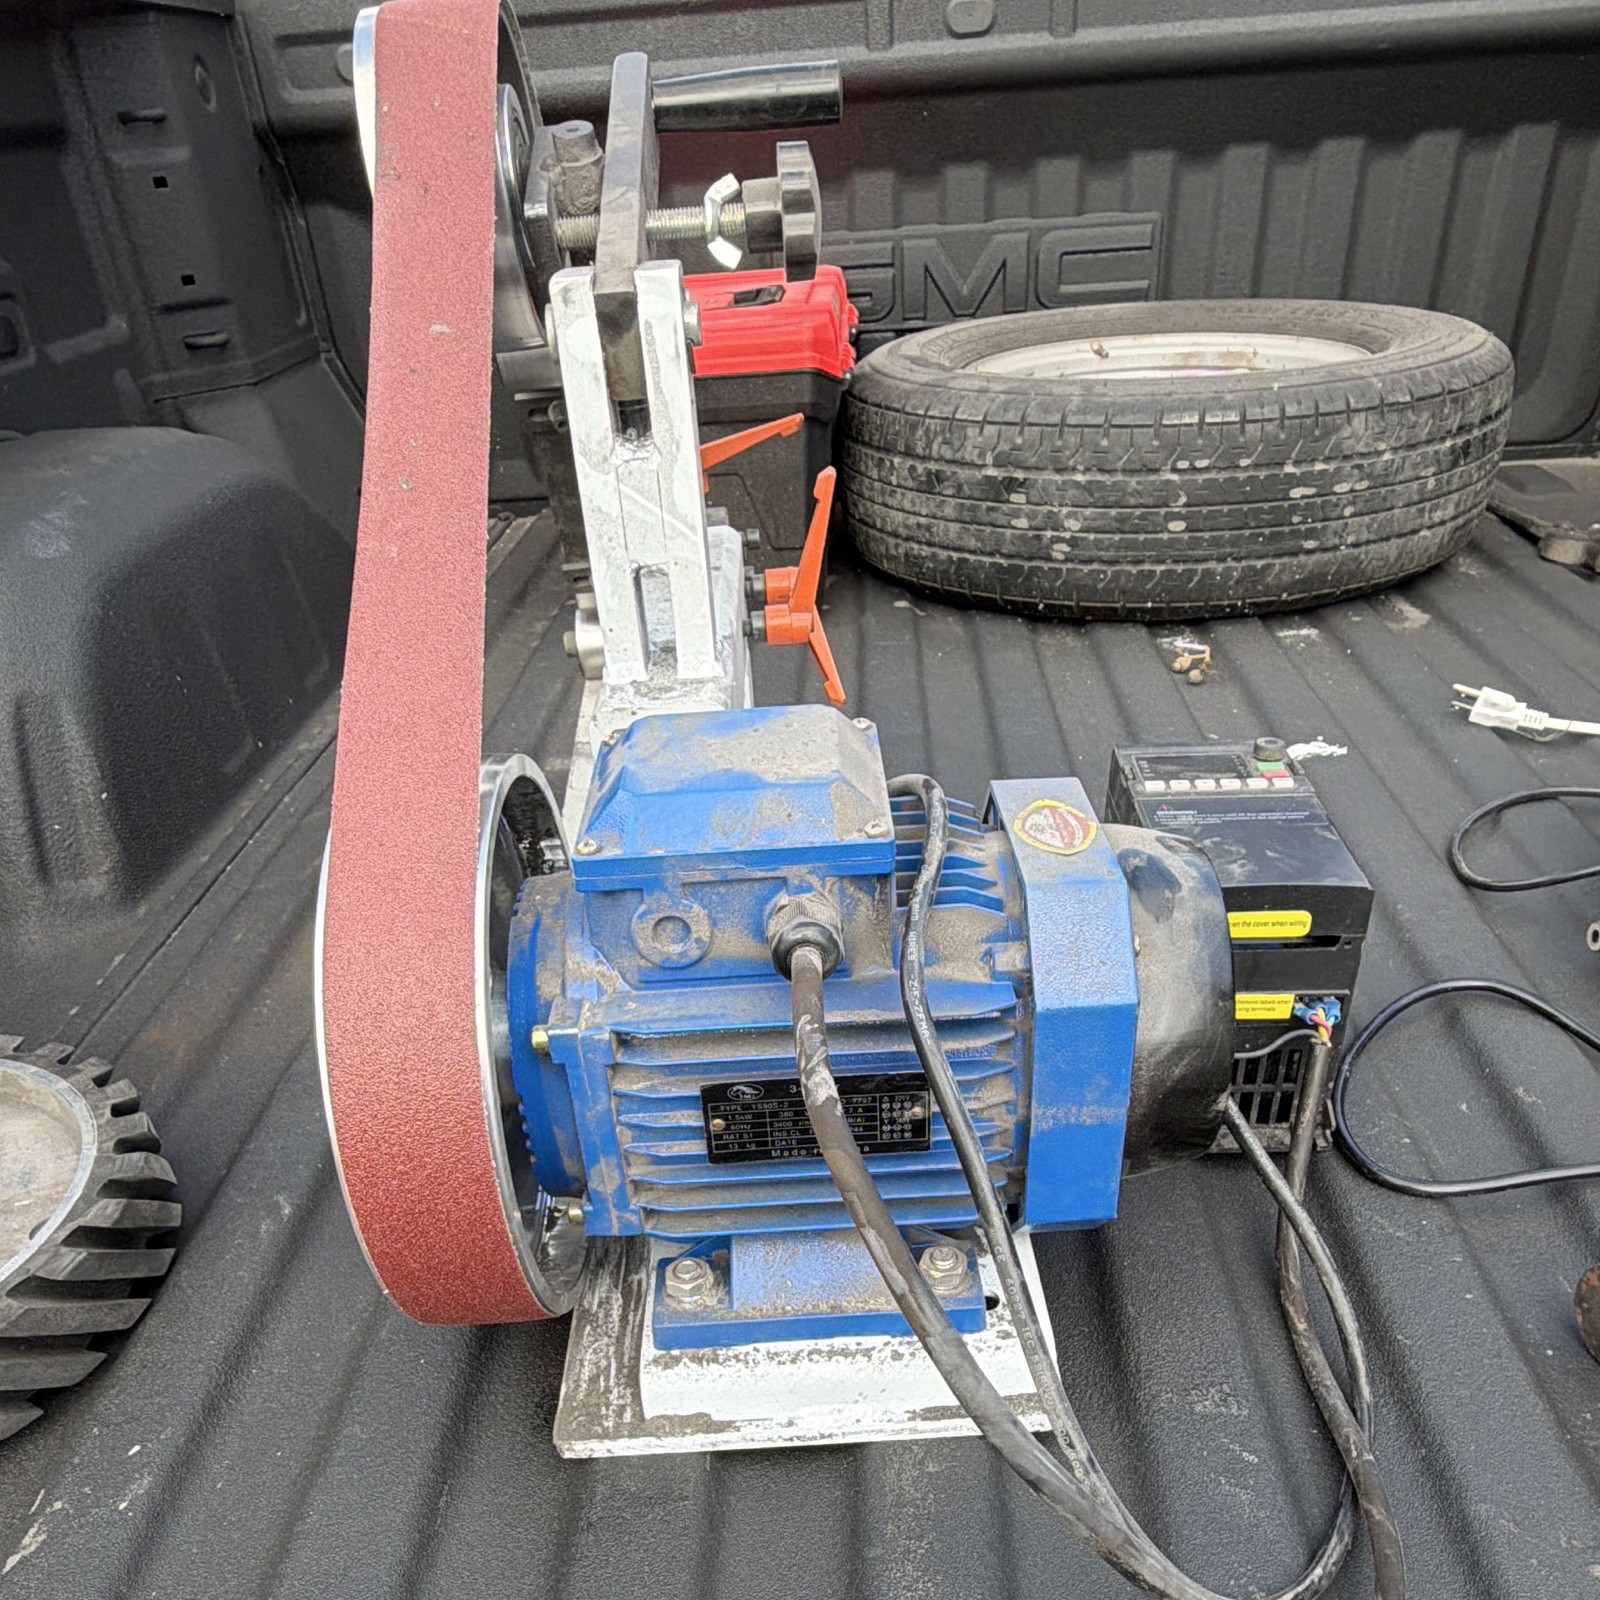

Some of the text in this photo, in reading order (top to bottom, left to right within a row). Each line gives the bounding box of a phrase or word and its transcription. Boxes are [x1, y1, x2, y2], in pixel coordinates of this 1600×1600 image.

[1289, 920, 1308, 929] wiring
[774, 1139, 797, 1147] DATE
[771, 1149, 807, 1157] Made
